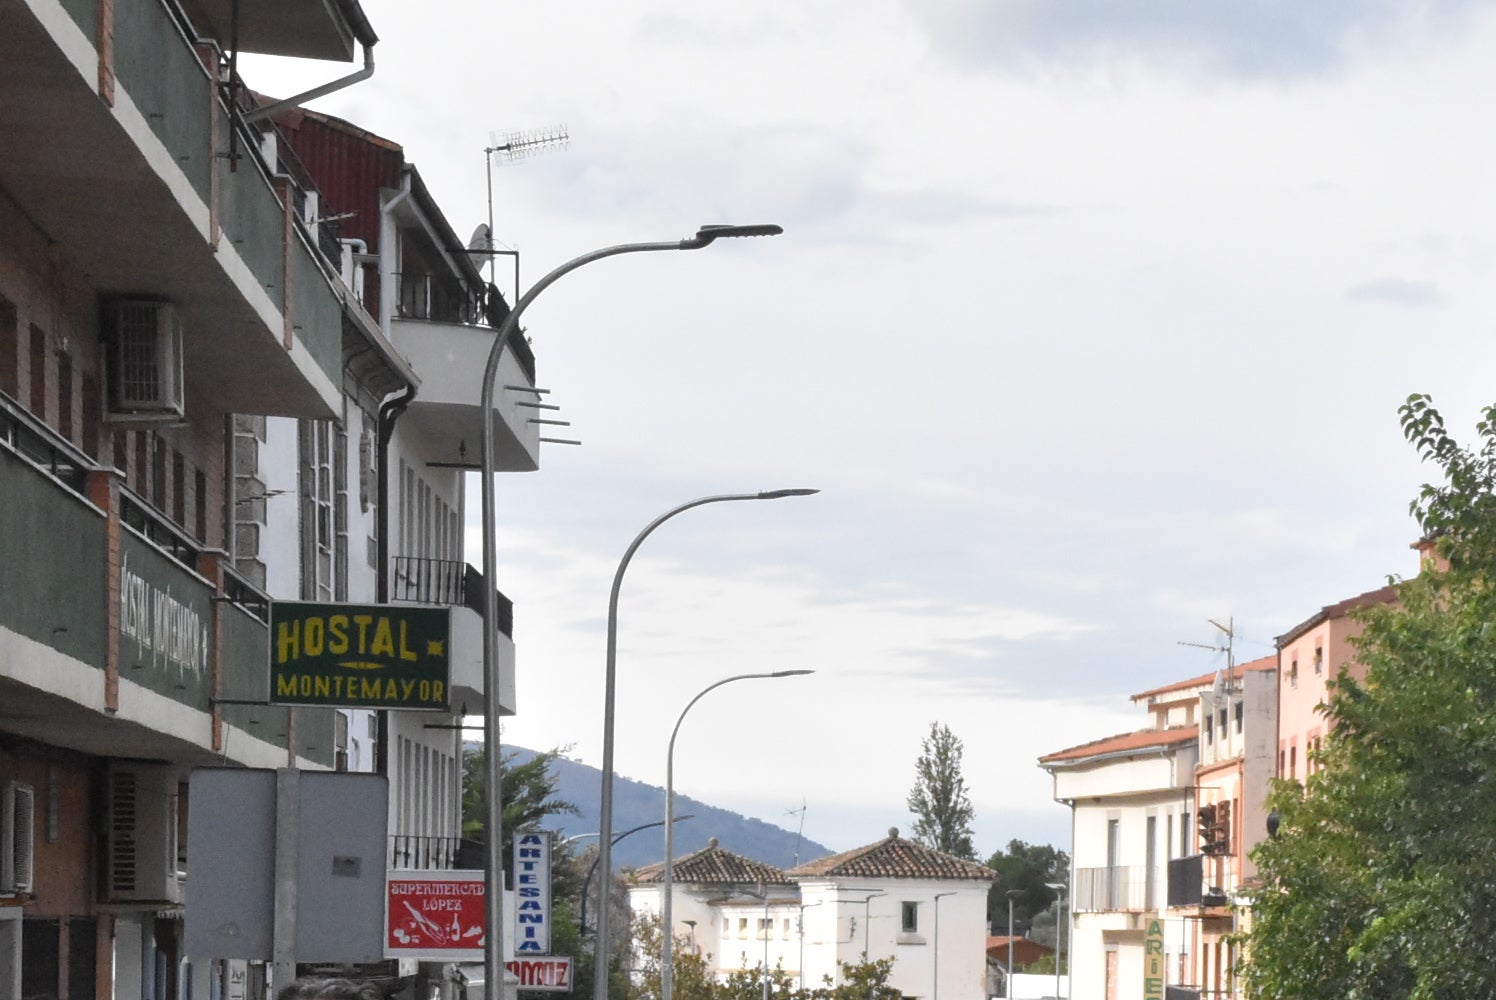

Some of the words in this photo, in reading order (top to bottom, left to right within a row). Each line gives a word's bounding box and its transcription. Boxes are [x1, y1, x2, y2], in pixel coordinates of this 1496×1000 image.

[277, 614, 418, 664] HOSTAL
[277, 673, 444, 703] MONTEMAYOR
[391, 882, 485, 896] SUPERMERCAD
[421, 897, 463, 911] LÓPEZ
[518, 834, 543, 951] ARTESANIA
